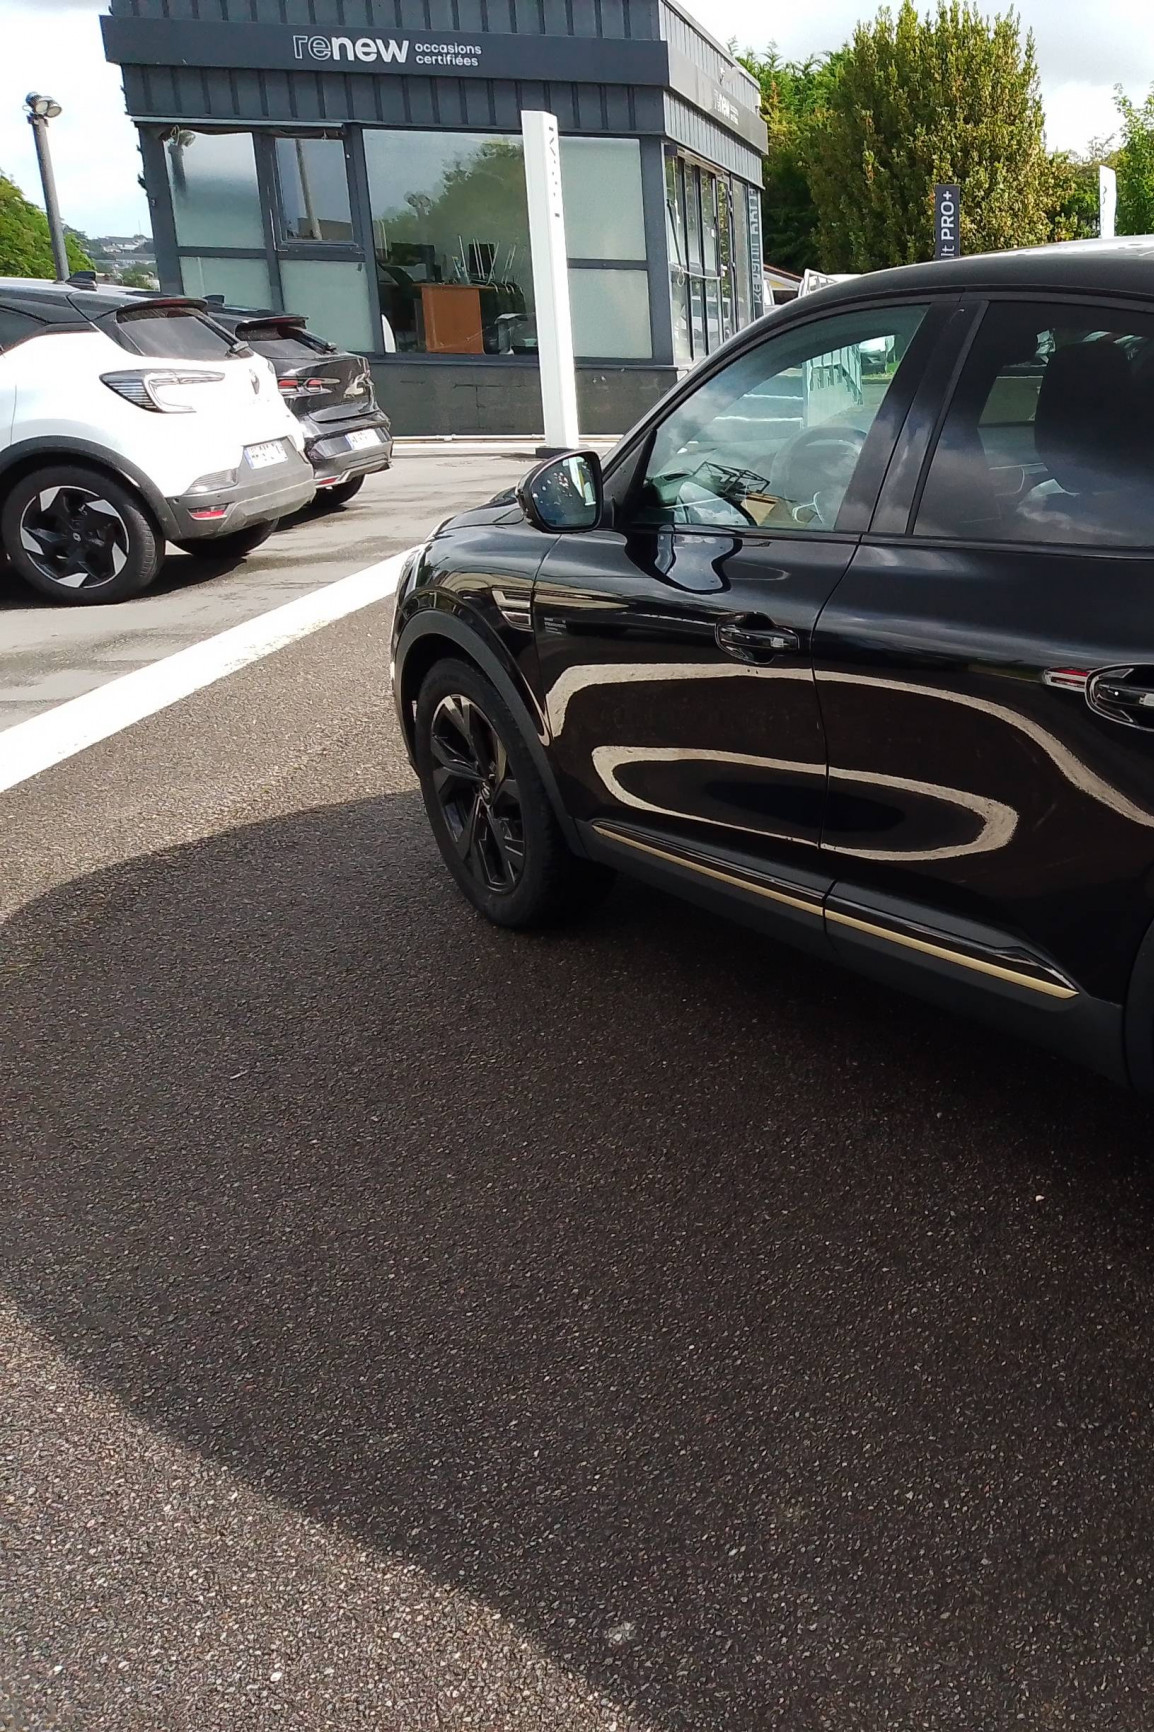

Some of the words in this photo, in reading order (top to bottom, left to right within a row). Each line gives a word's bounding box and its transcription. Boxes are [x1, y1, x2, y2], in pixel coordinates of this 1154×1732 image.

[293, 35, 410, 63] renew
[414, 42, 482, 54] occasions
[415, 53, 479, 67] certifiées
[940, 190, 955, 241] PRO+
